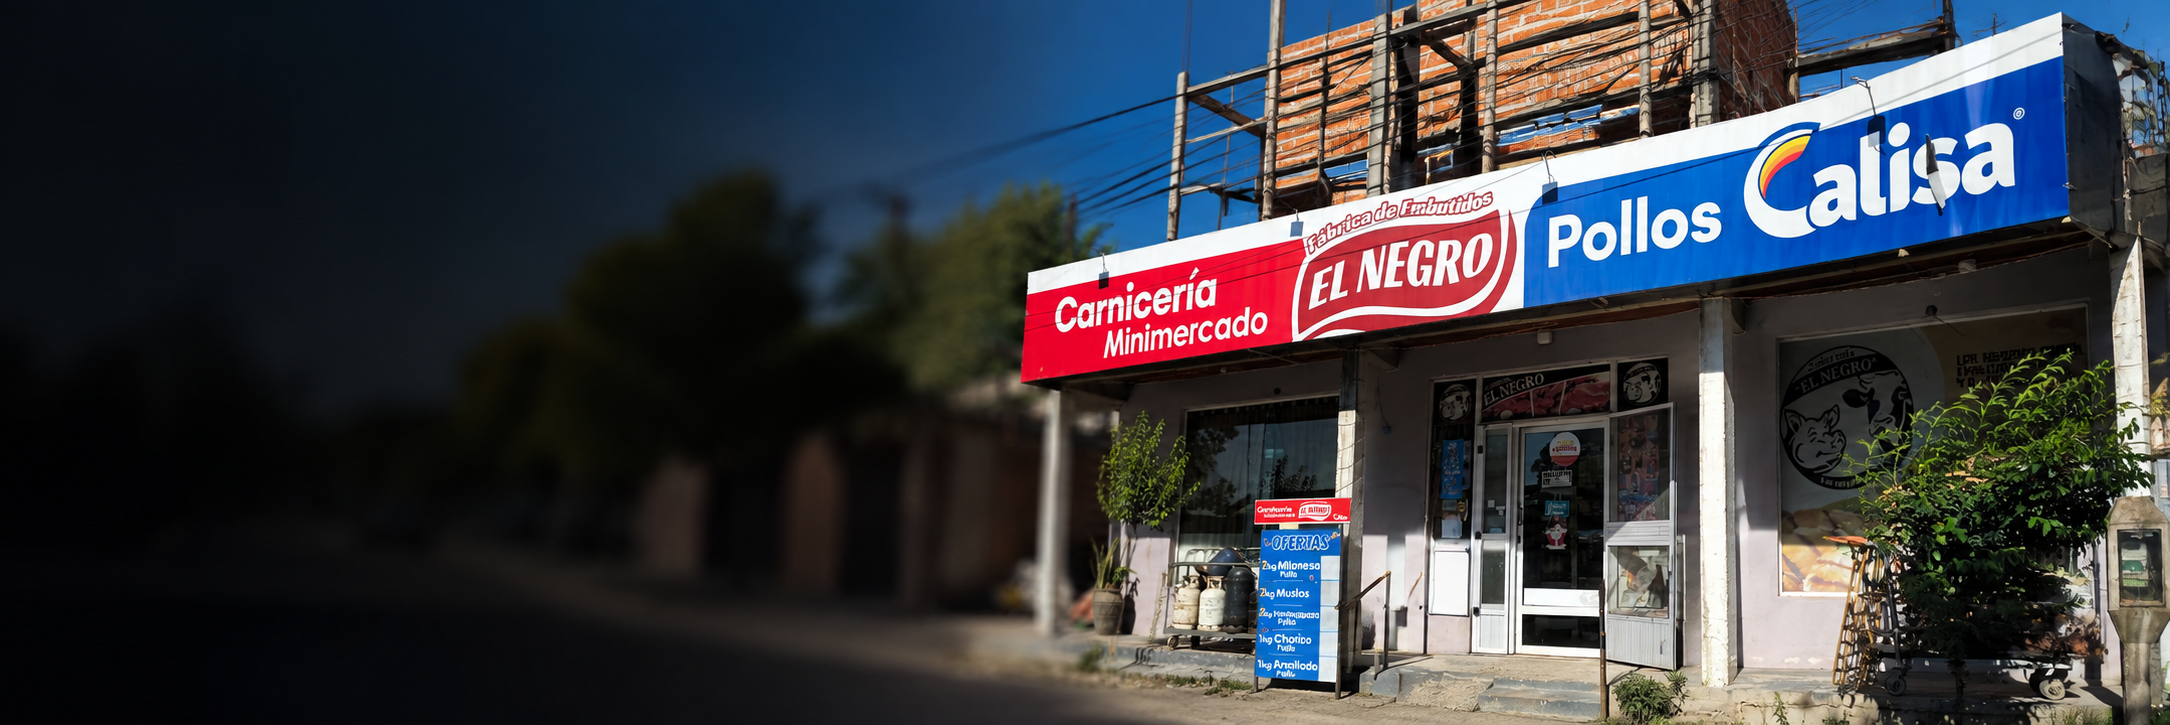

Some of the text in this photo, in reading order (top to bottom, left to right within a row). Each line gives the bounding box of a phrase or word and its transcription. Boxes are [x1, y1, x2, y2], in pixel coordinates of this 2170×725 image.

[1306, 190, 1495, 255] Fábrica de Embutidos
[1547, 196, 1722, 268] Pollos
[1743, 122, 2016, 240] Calisa
[1054, 266, 1217, 334] Carnicería
[1308, 232, 1494, 311] EL NEGRO
[1102, 306, 1269, 360] Minimercado
[1484, 391, 1501, 406] EL
[1499, 373, 1545, 398] NEGRO
[1271, 534, 1329, 551] OFERTAS
[1276, 588, 1310, 599] Muslos
